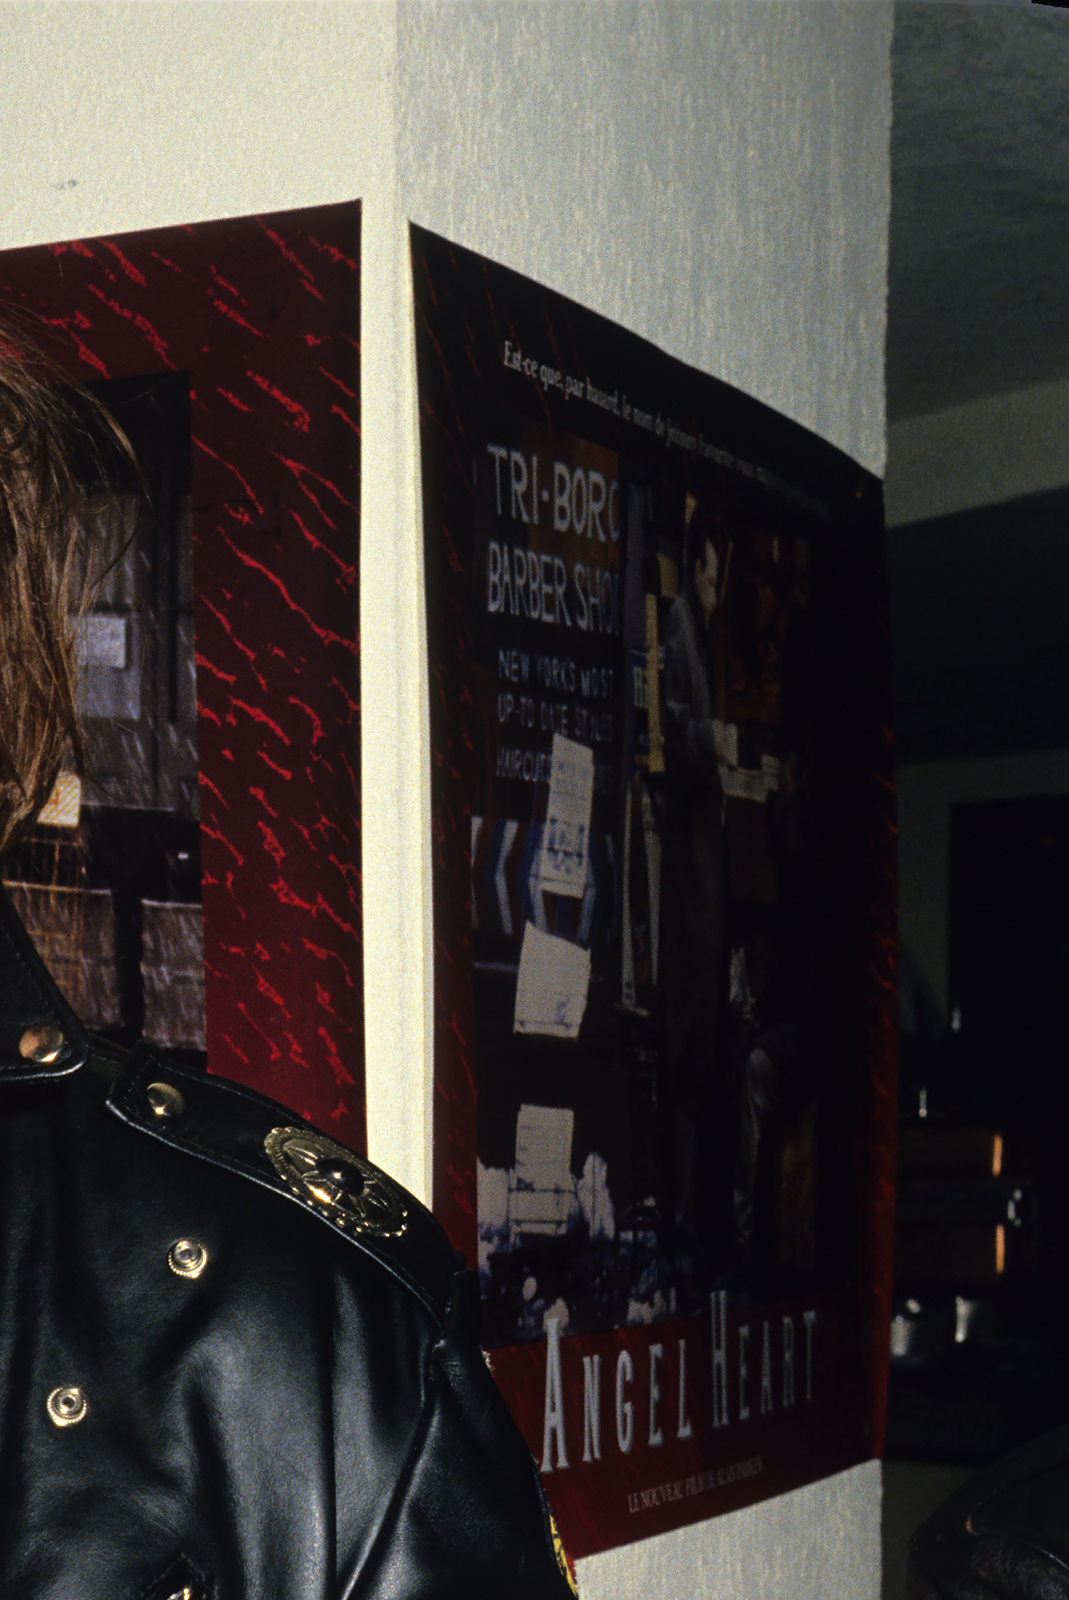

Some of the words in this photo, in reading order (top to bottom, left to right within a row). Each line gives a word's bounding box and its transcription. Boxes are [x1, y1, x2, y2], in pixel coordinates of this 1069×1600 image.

[487, 539, 572, 627] BARBER
[573, 562, 619, 637] SHO
[498, 648, 530, 683] NEW
[580, 666, 614, 699] MOST
[496, 692, 535, 729] UP-TO
[540, 700, 569, 736] DATE
[539, 1316, 693, 1474] ANGEL
[709, 1289, 818, 1429] HEART
[626, 1492, 640, 1515] LE
